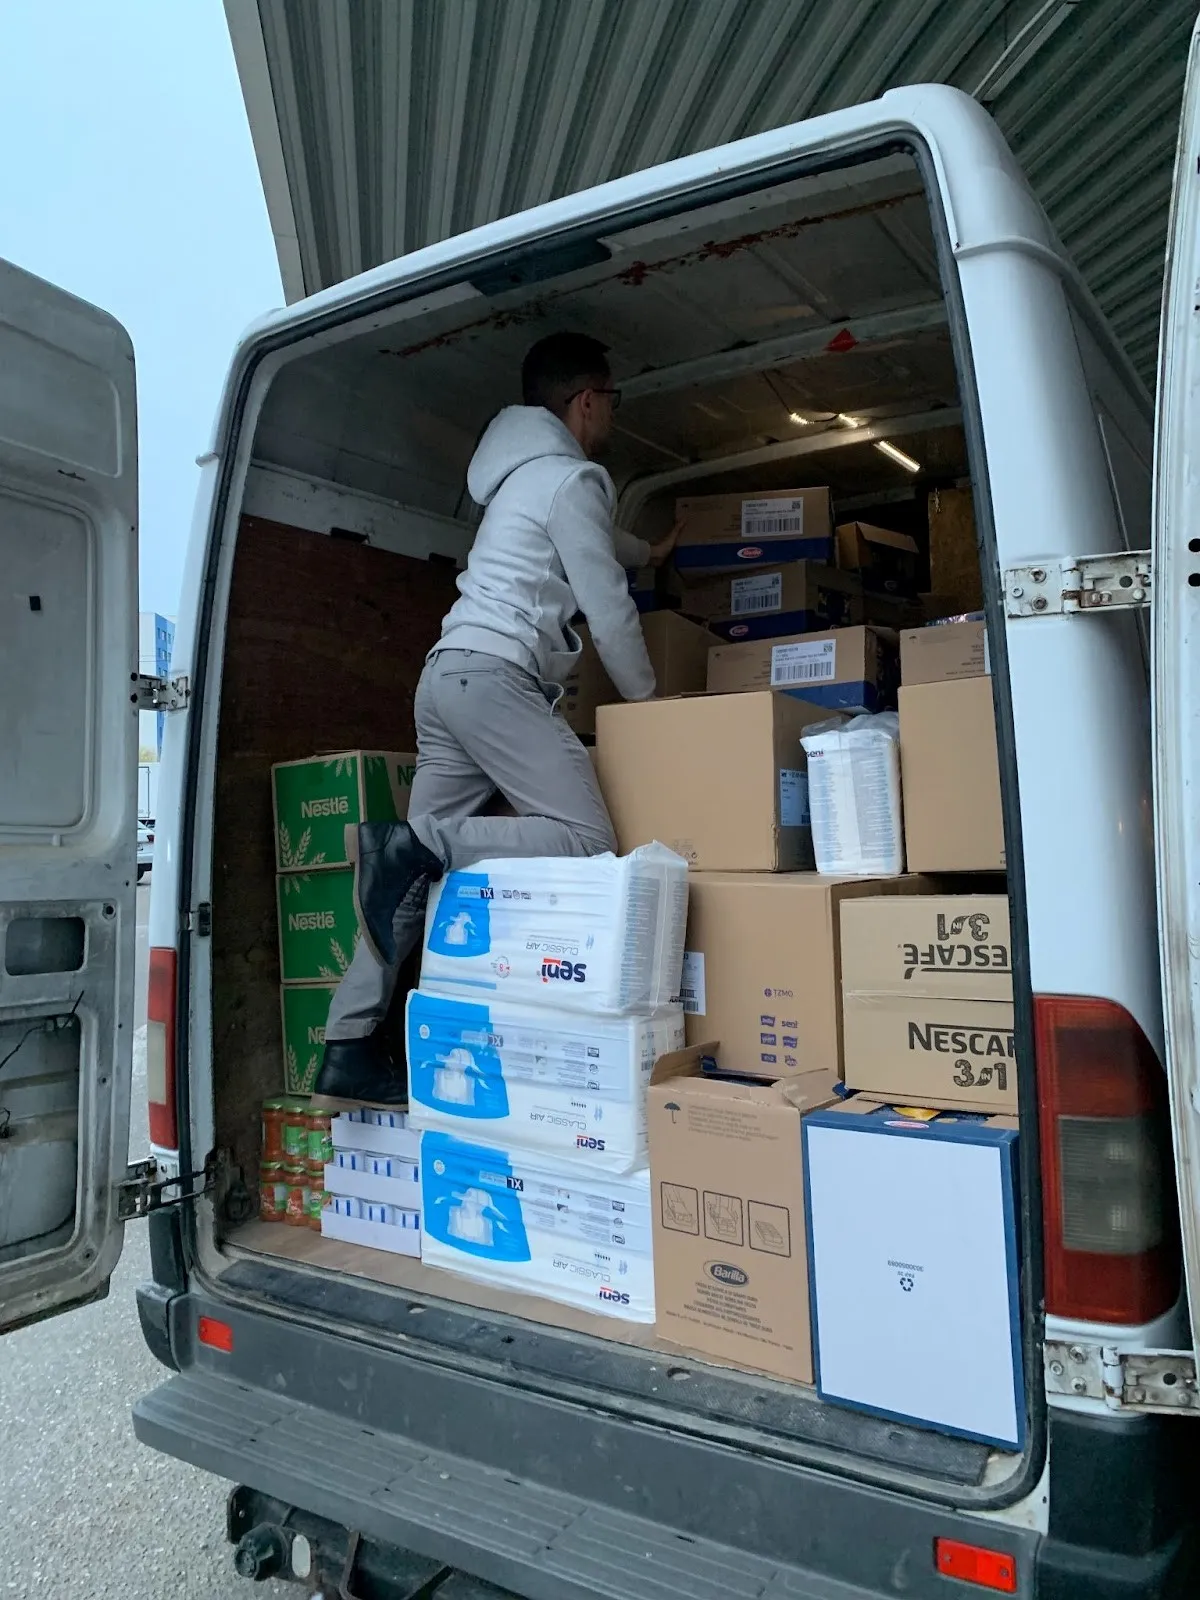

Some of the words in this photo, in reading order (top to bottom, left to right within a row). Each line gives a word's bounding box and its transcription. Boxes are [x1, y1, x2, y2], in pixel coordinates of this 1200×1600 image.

[301, 796, 349, 818] Nestlé
[288, 911, 336, 931] Nestlé
[526, 942, 540, 950] AIR
[542, 943, 579, 956] CLASSIC
[903, 943, 1010, 979] ESCAFÉ
[541, 959, 587, 983] seni
[774, 989, 793, 997] TZMO
[908, 1022, 1015, 1058] NESCAF
[530, 1112, 545, 1122] AIR
[547, 1115, 587, 1130] CLASSIC
[576, 1135, 606, 1151] seni
[552, 1258, 568, 1270] AIR
[570, 1264, 611, 1283] CLASSIC
[714, 1266, 745, 1282] Barilla
[599, 1286, 630, 1305] seni
